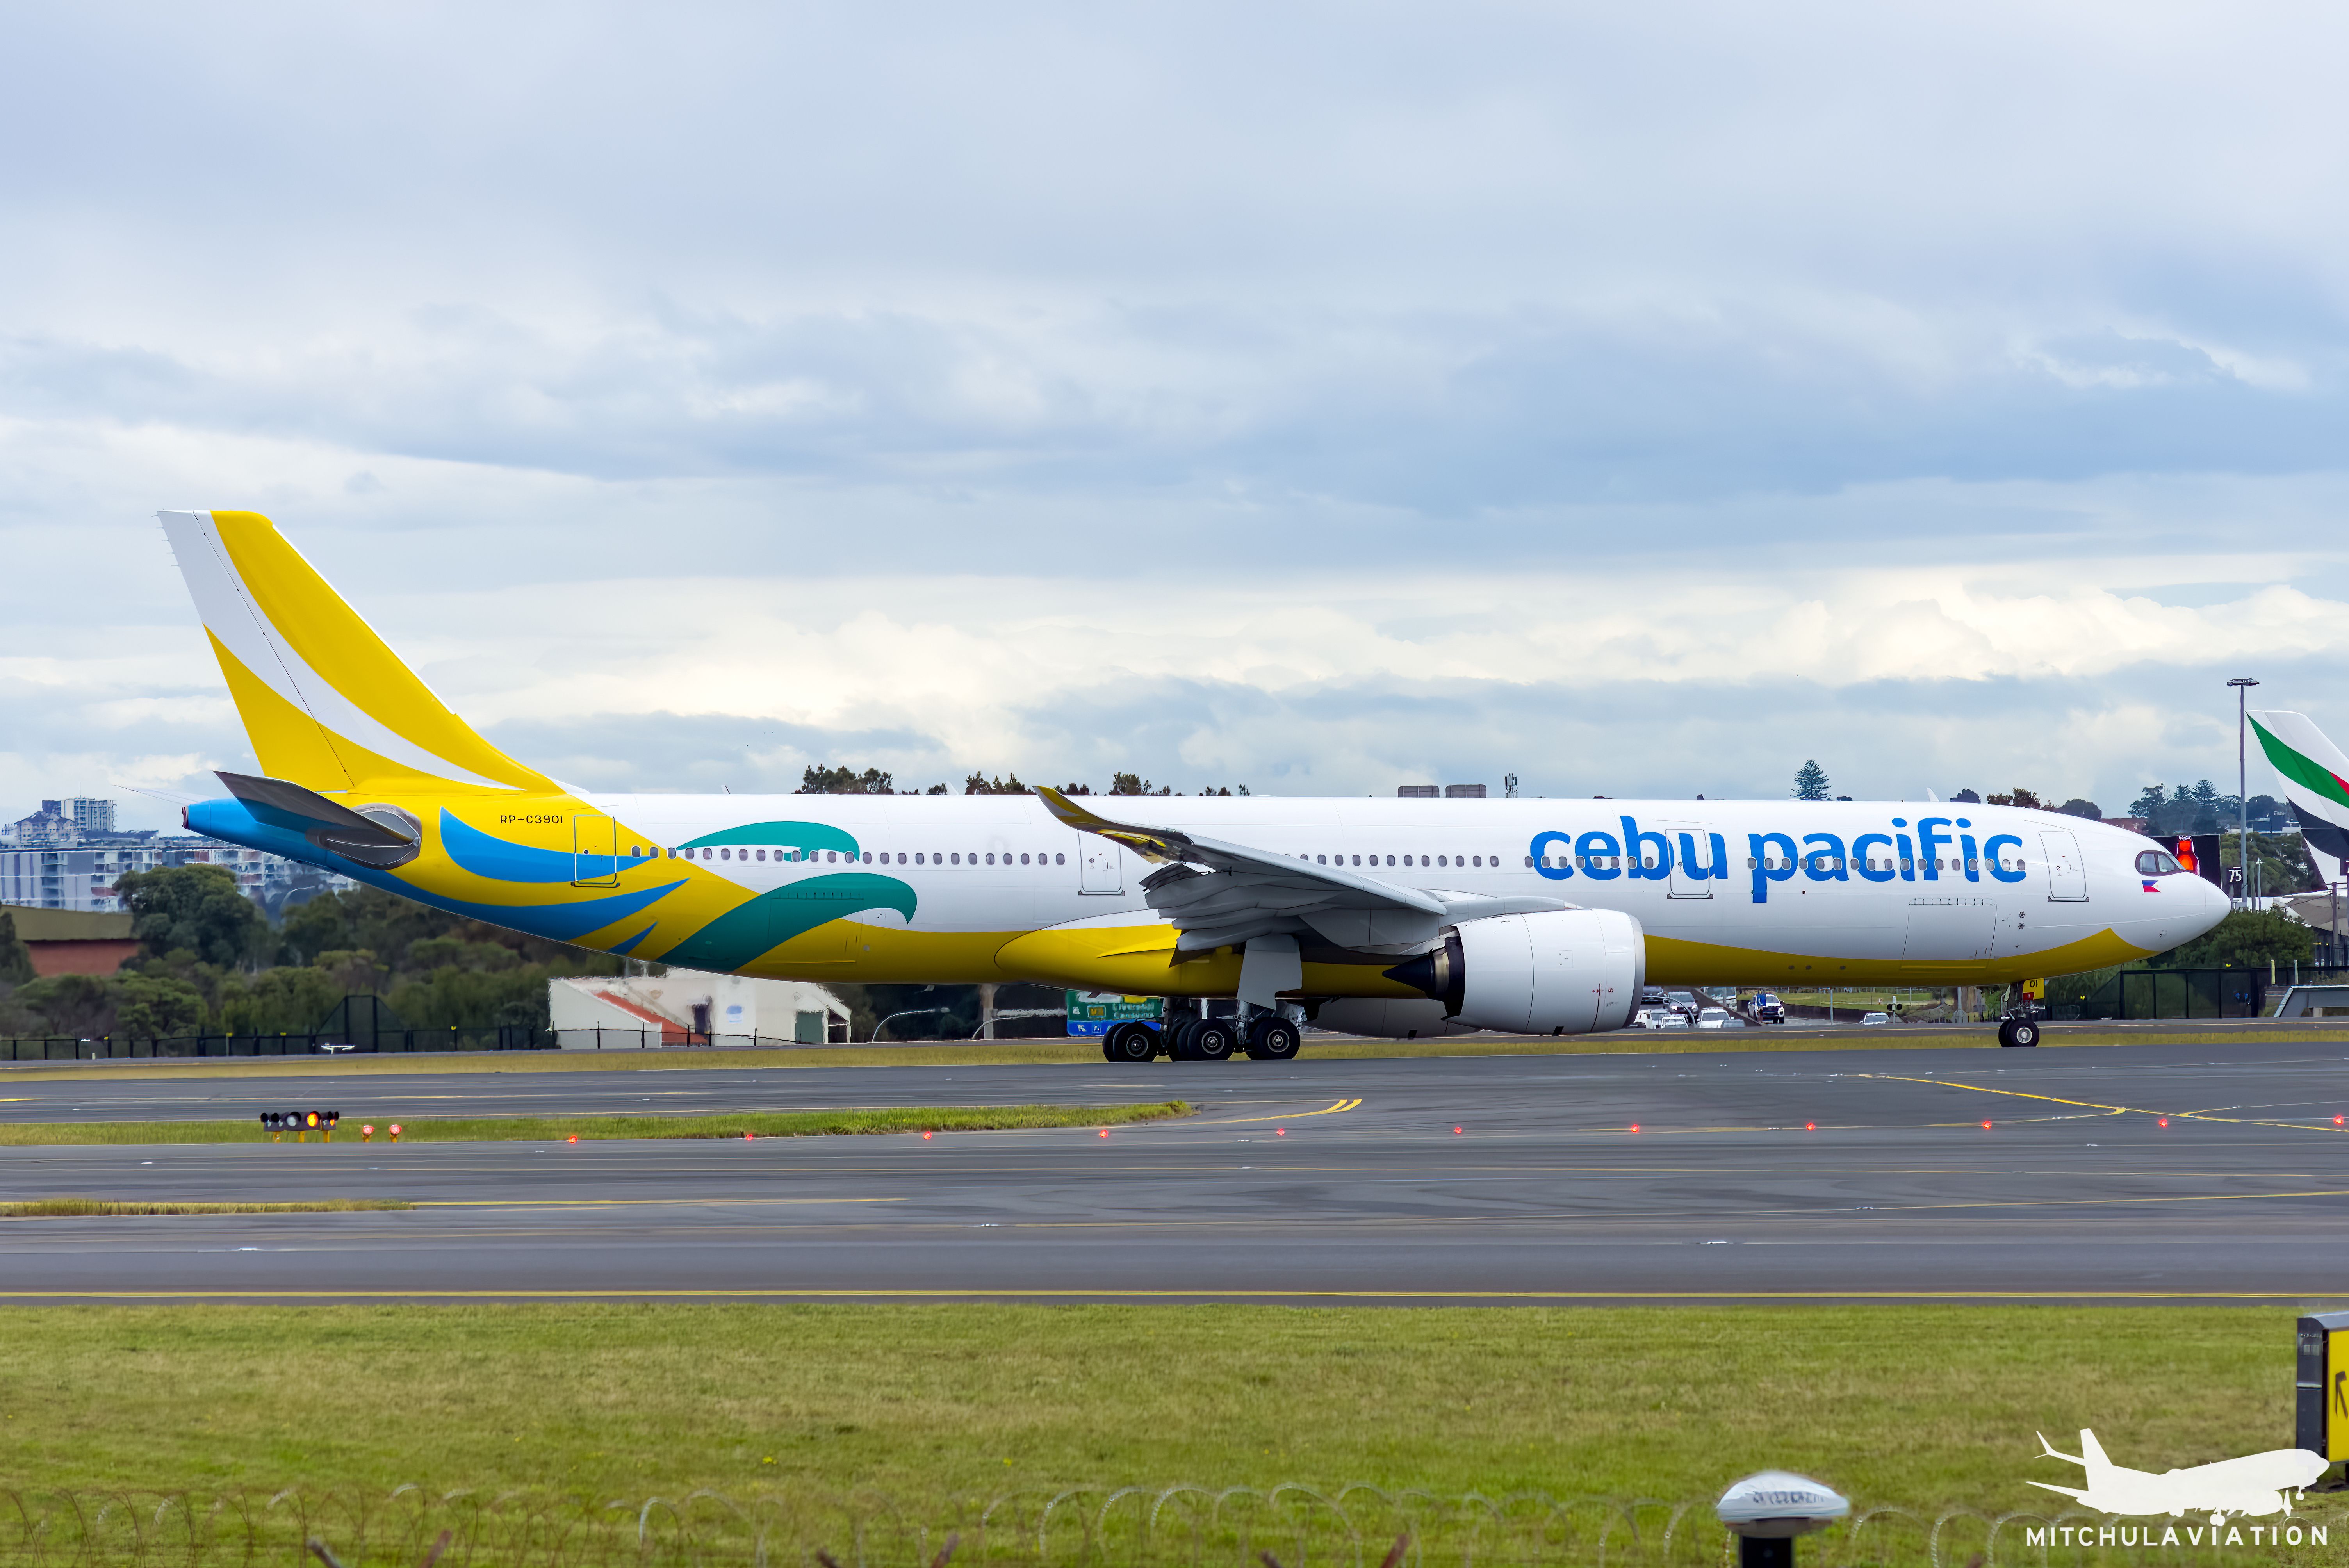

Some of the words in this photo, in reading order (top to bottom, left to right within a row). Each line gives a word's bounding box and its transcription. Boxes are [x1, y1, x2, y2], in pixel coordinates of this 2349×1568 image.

[500, 815, 563, 824] RP-C3901
[1530, 815, 1728, 881] cebu
[1748, 817, 2026, 903] pacific
[2228, 869, 2242, 882] 75
